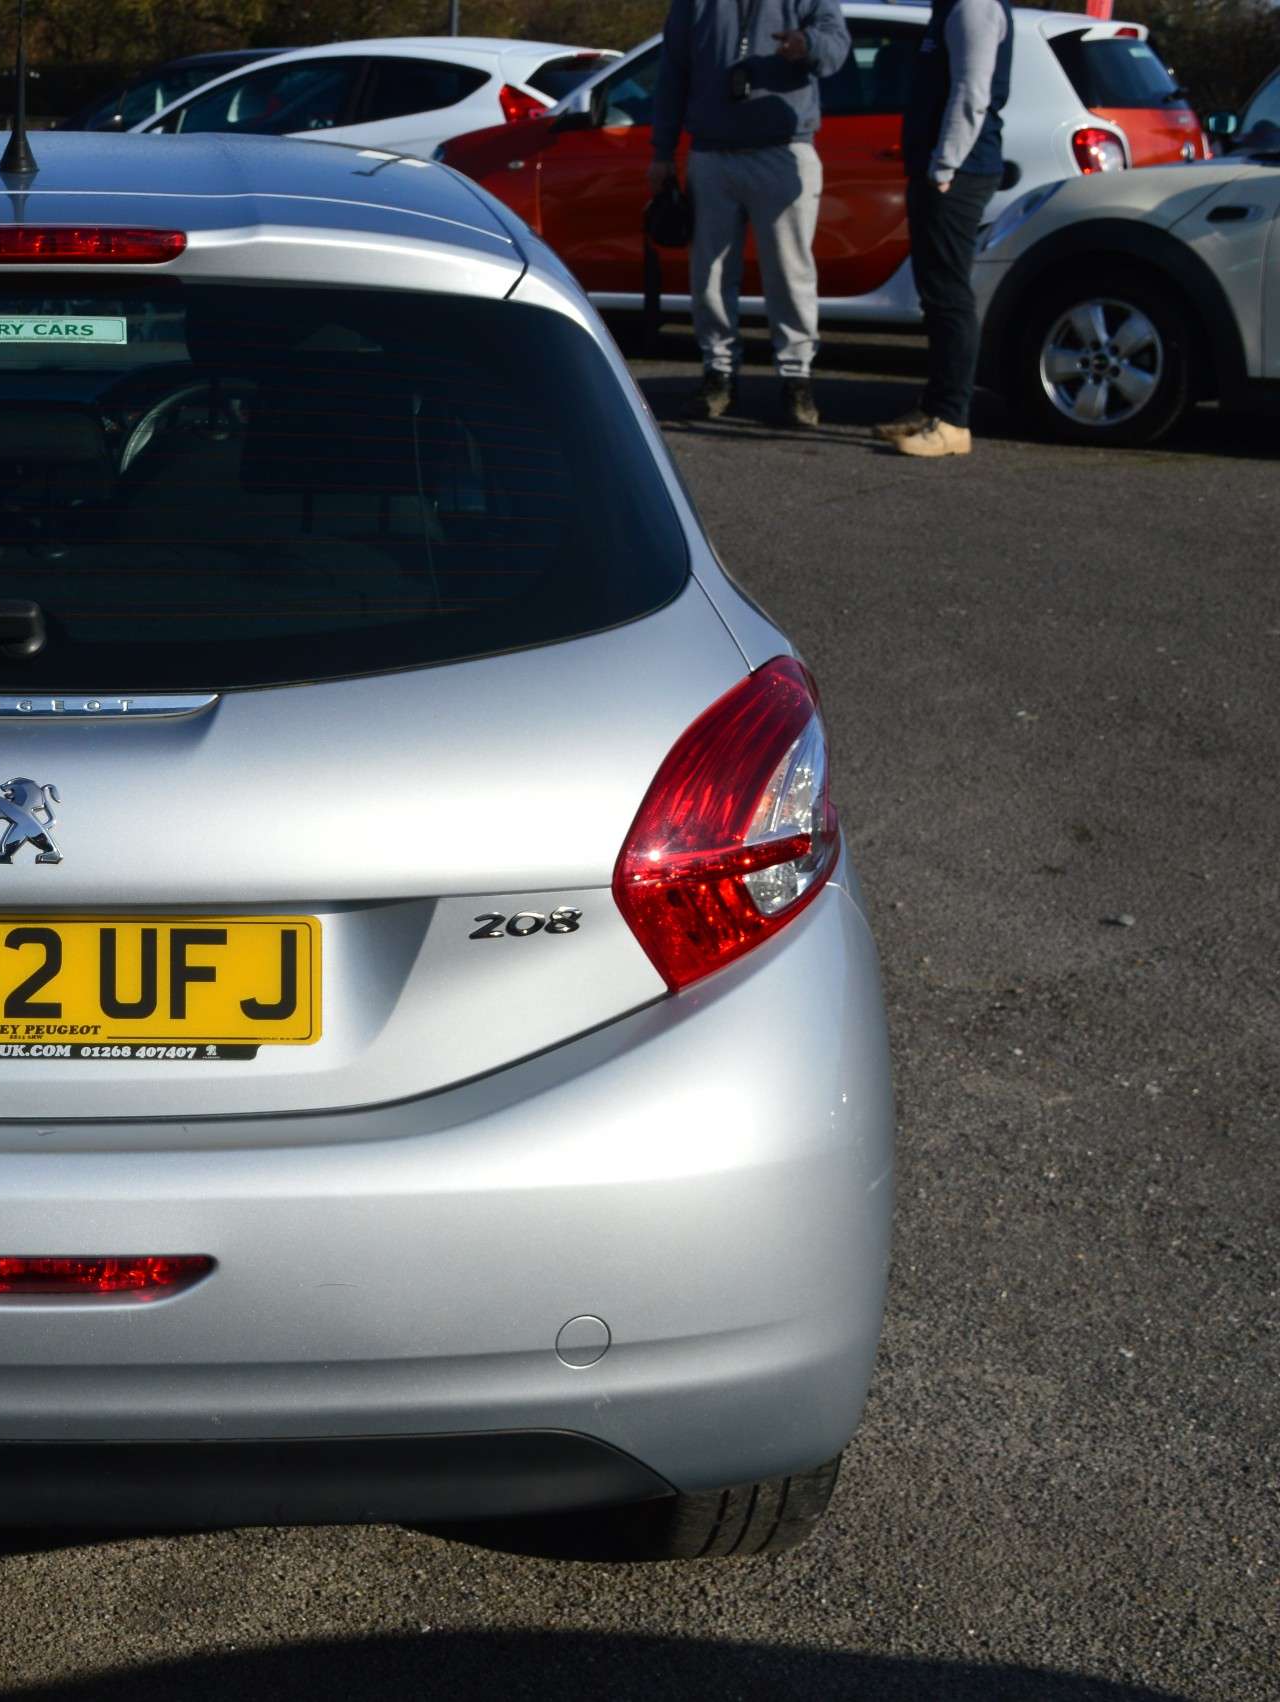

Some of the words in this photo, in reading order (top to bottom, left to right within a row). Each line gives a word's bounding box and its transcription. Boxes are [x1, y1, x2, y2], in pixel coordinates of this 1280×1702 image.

[33, 323, 94, 336] CARS
[469, 906, 583, 940] 208
[99, 928, 298, 1021] UFJ
[24, 1024, 101, 1035] PEUGEOT
[81, 1045, 132, 1058] 01268
[135, 1046, 197, 1059] 407407
